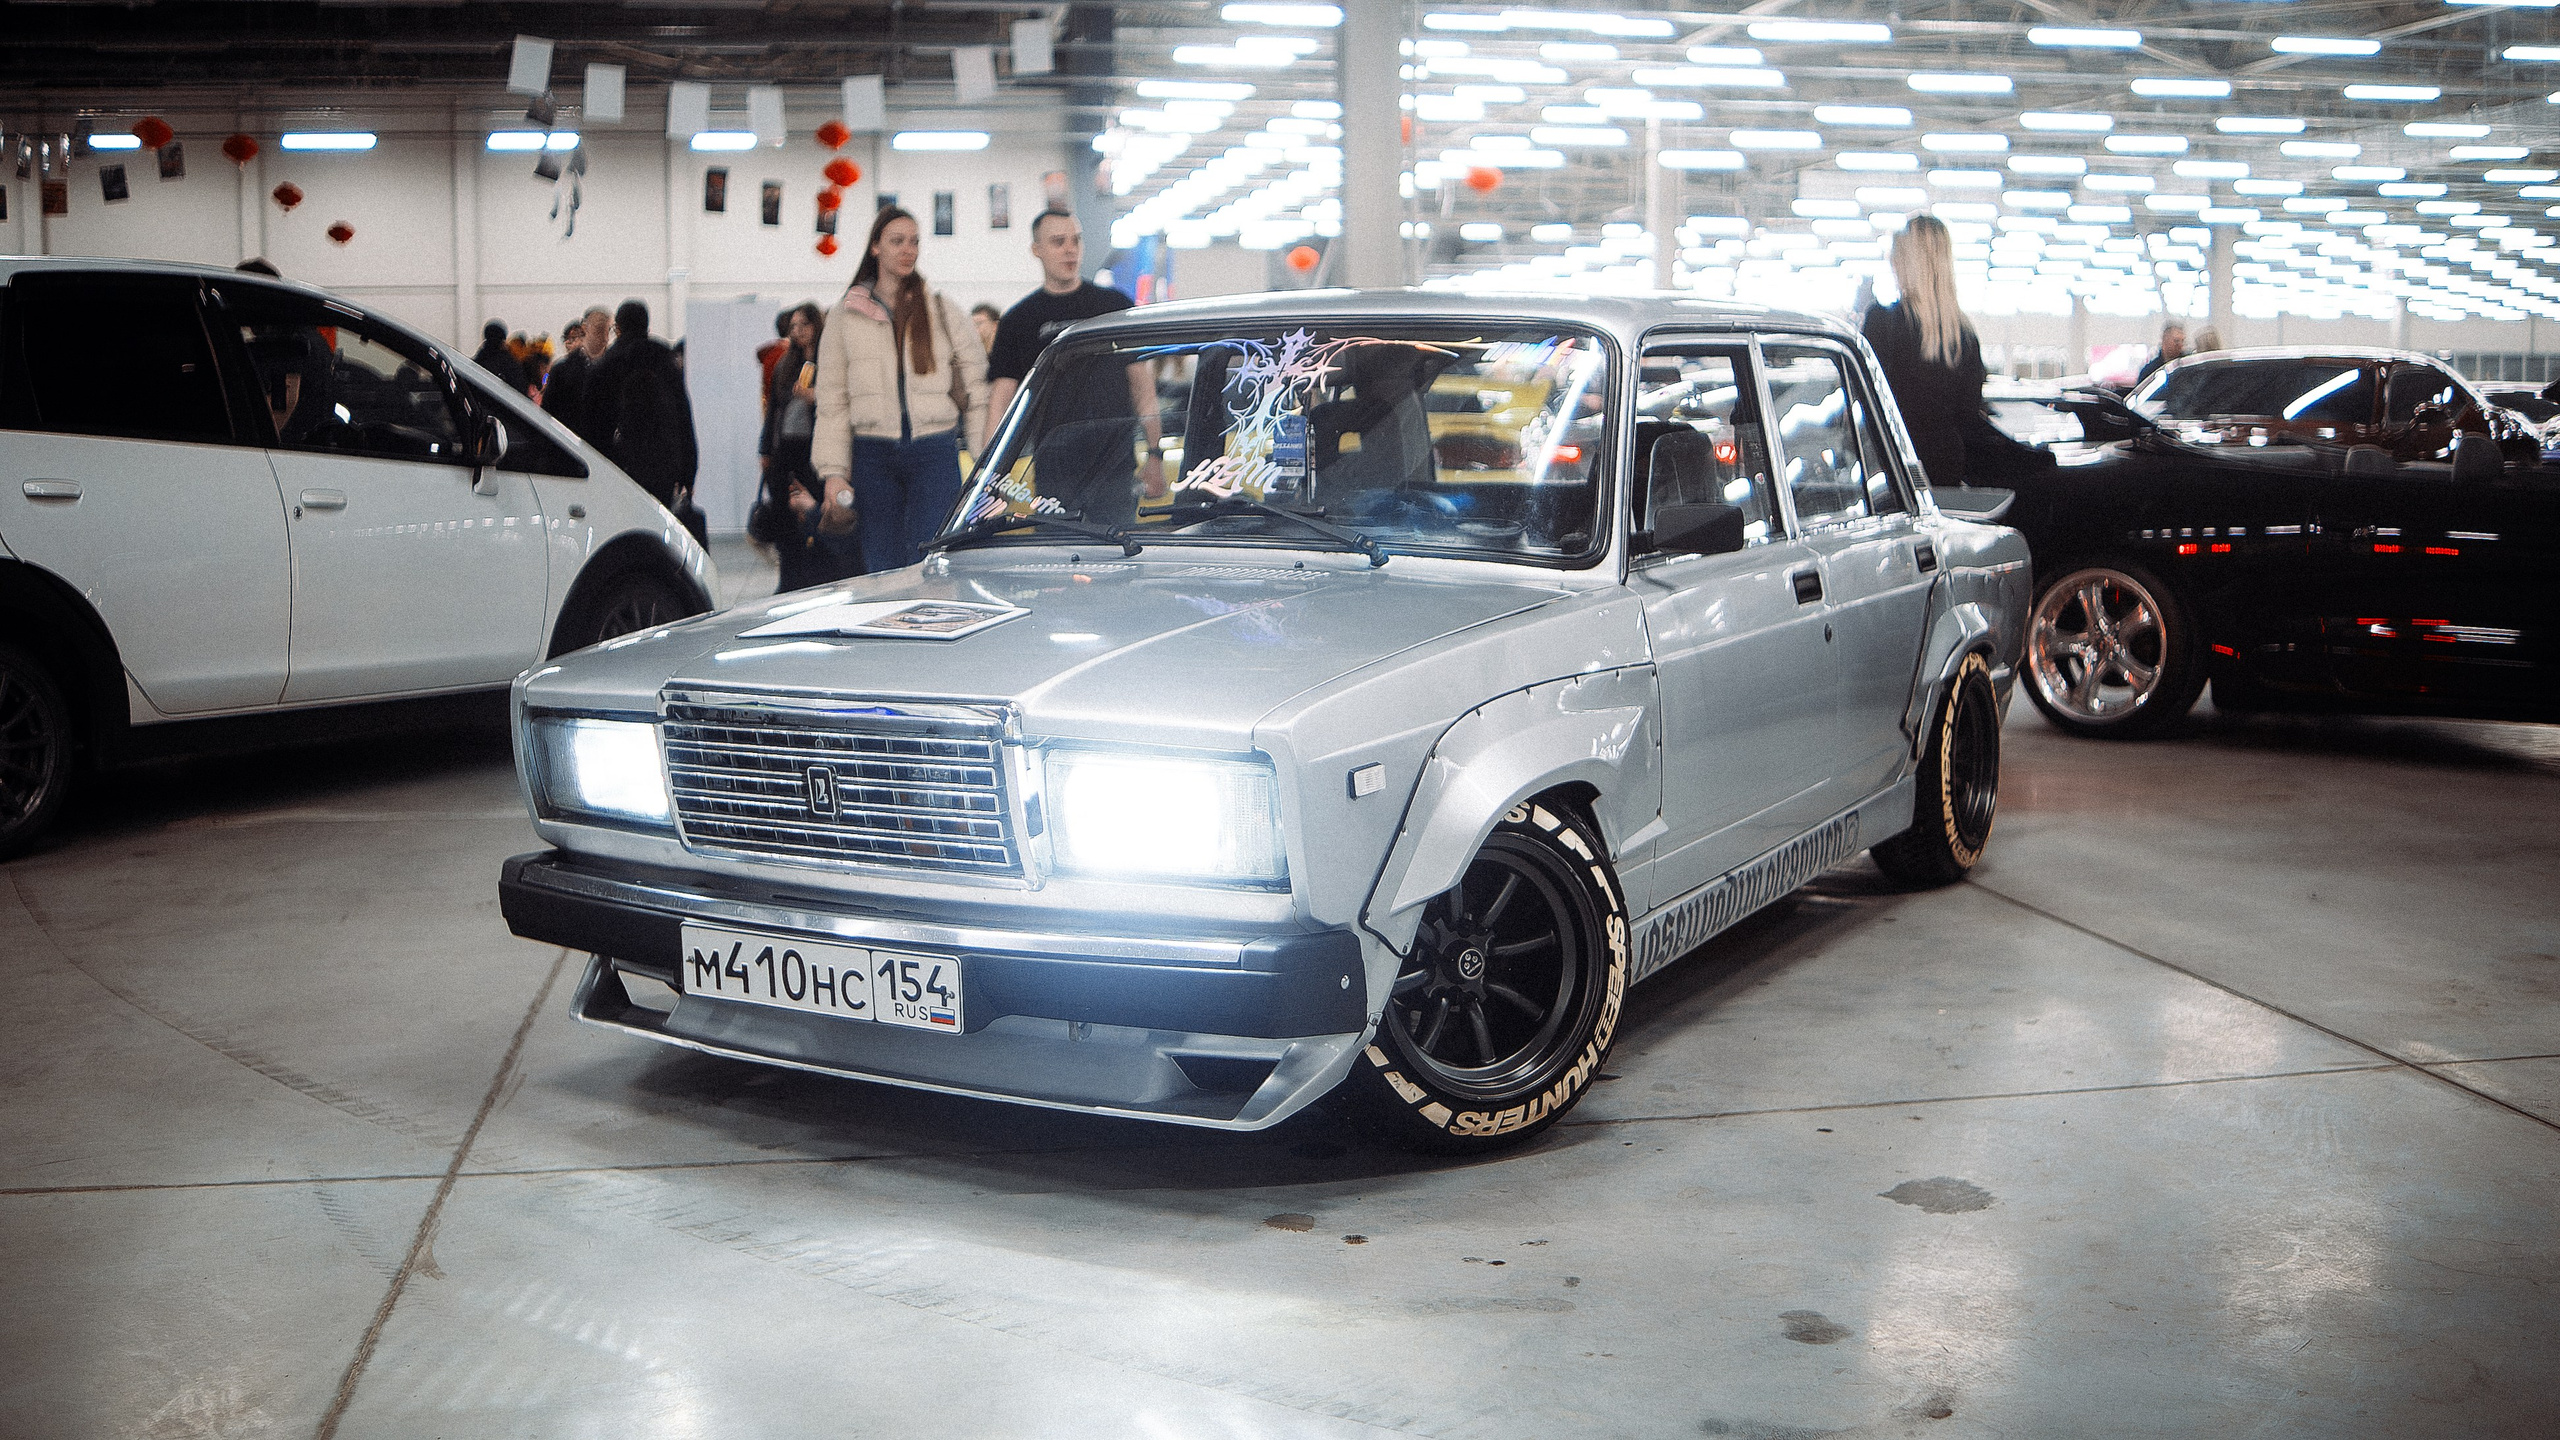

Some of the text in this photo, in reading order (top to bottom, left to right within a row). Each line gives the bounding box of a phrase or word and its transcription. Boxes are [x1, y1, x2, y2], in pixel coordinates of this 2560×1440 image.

[877, 958, 949, 1007] 154
[894, 1003, 928, 1021] RUS
[1594, 913, 1628, 1051] SPEED
[1449, 1041, 1599, 1136] HUNTERS
